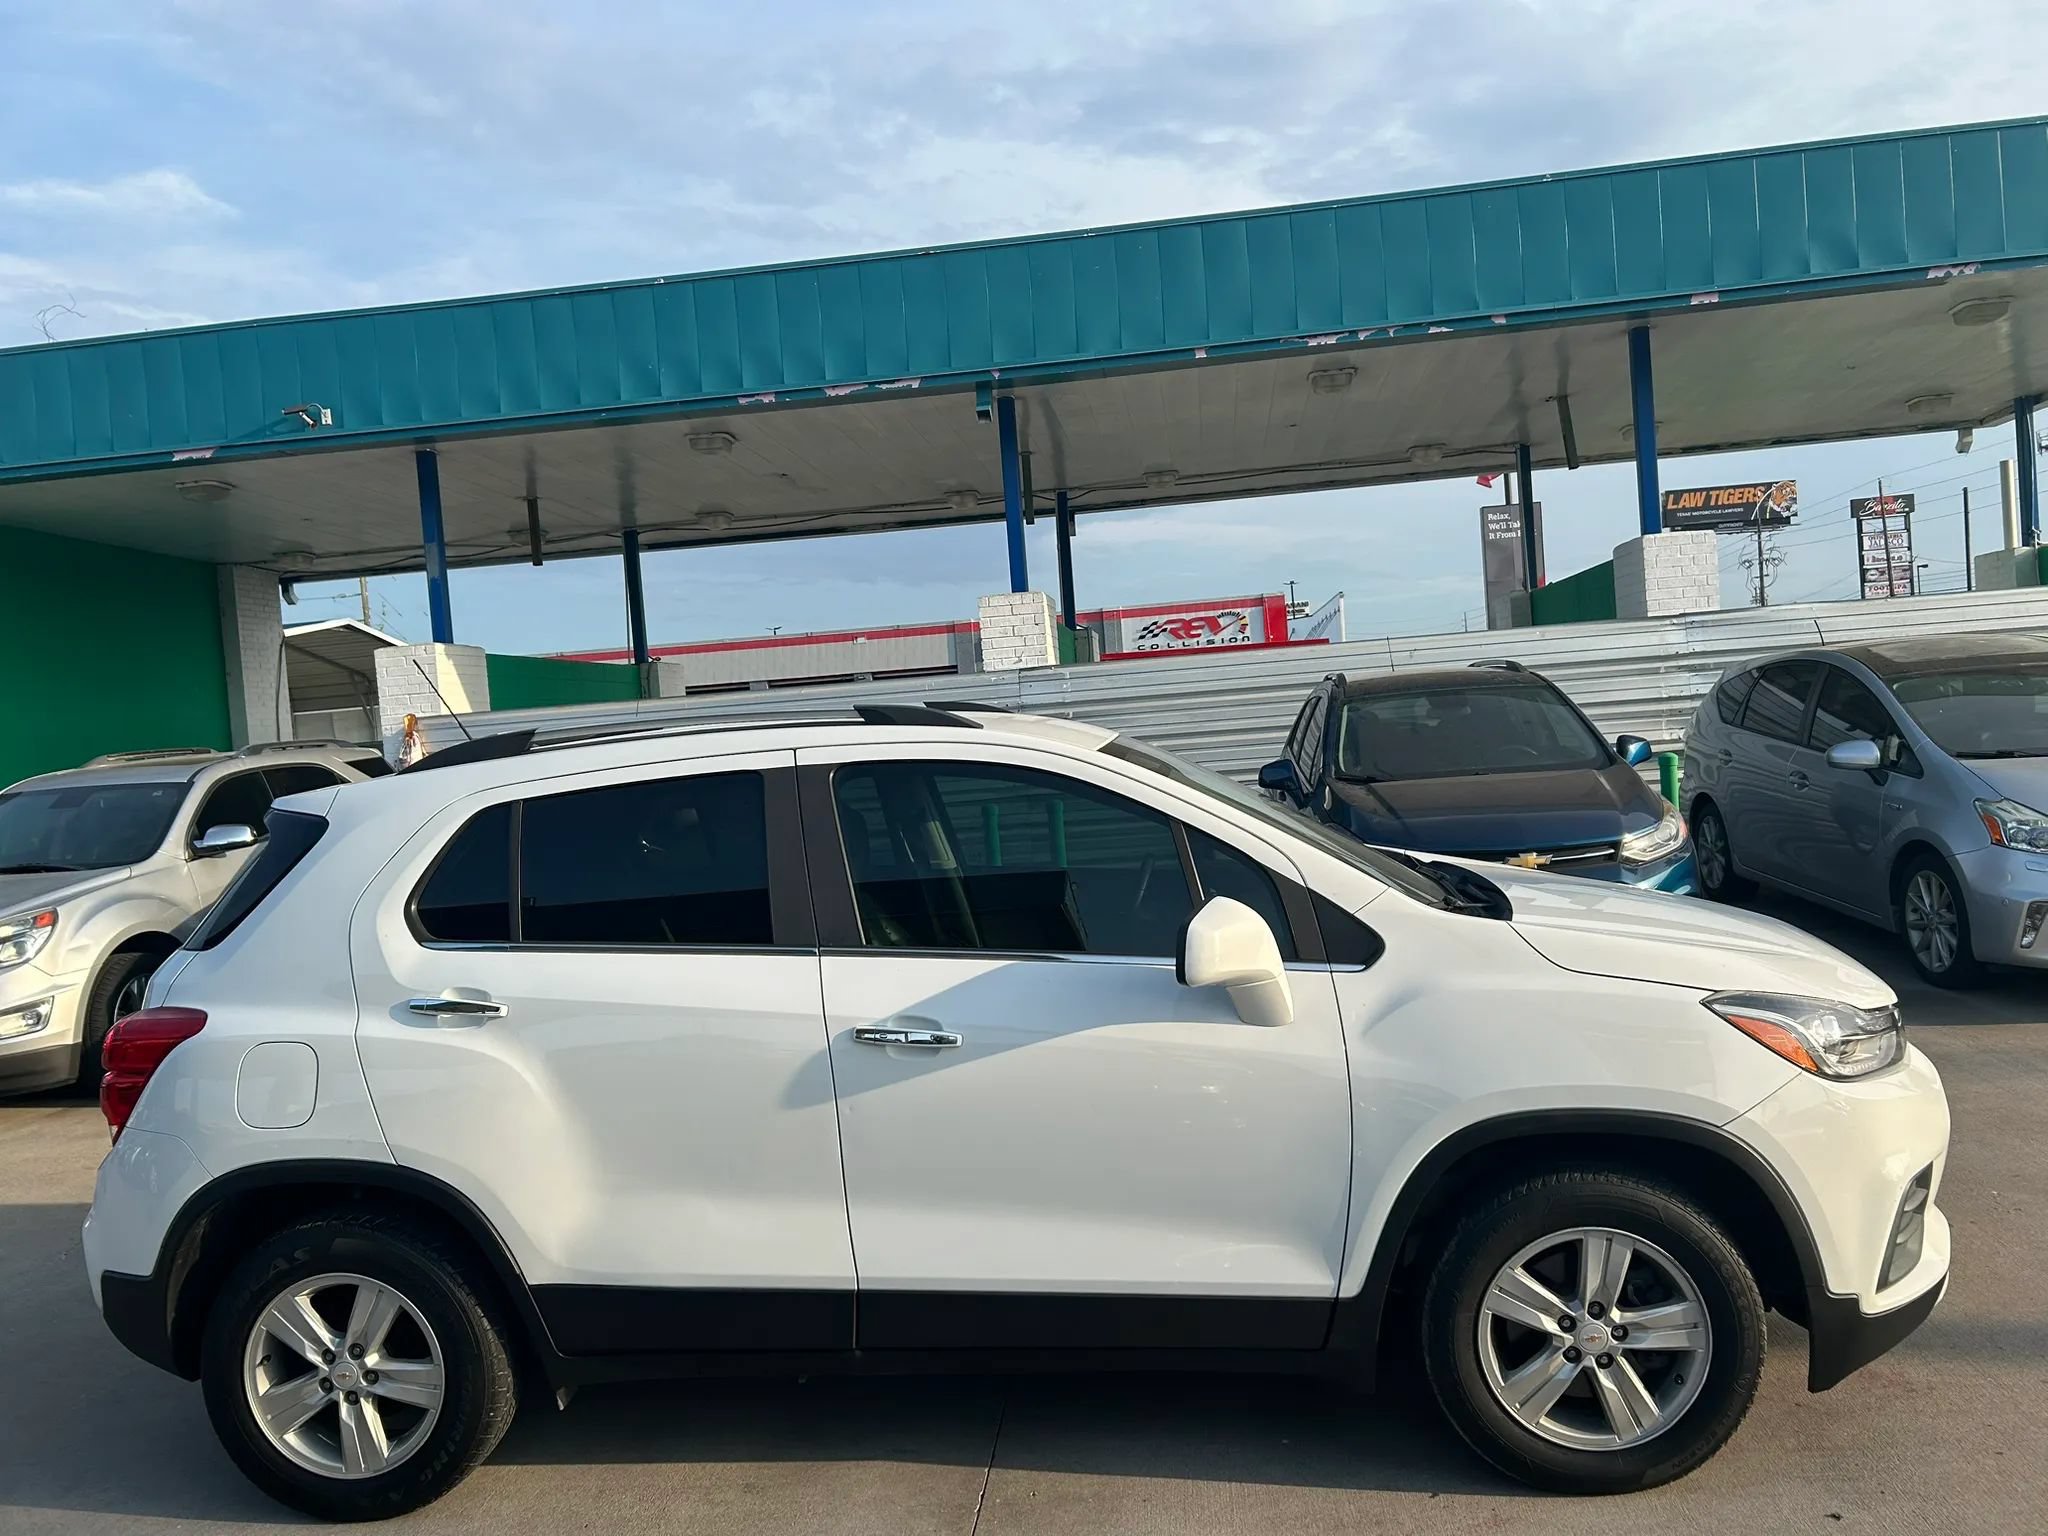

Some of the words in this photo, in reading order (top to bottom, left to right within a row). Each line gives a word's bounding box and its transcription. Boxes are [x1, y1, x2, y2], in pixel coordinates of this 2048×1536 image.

[1667, 492, 1707, 509] LAW
[1709, 486, 1766, 506] TIGERS
[1487, 512, 1511, 521] Relax,
[1488, 522, 1507, 530] We'll
[1496, 531, 1516, 539] From
[1869, 538, 1904, 547] JALCO
[1161, 616, 1222, 640] REV
[1137, 635, 1251, 651] COLLISION
